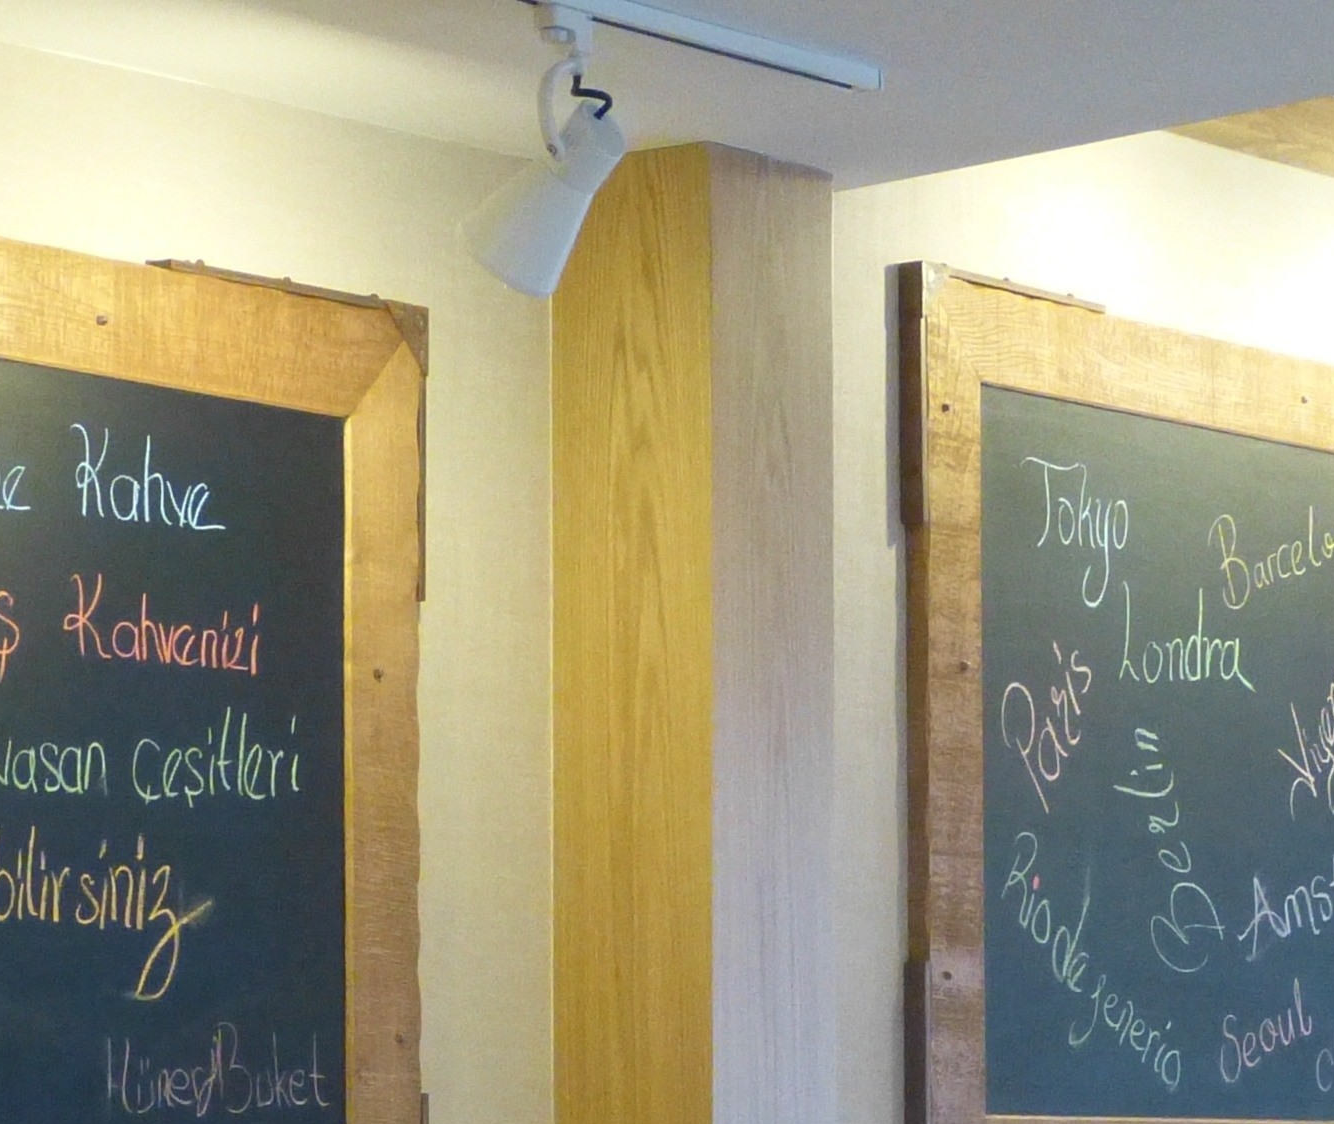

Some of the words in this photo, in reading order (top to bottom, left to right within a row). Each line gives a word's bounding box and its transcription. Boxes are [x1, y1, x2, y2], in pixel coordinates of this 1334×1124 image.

[68, 423, 225, 530] Kahve
[1020, 457, 1129, 608] Tokyo
[63, 573, 261, 677] Kahvenizi
[1119, 580, 1257, 693] Londra
[1001, 640, 1092, 814] Paris
[1113, 727, 1226, 973] Berlin
[1220, 978, 1313, 1083] Seoul
